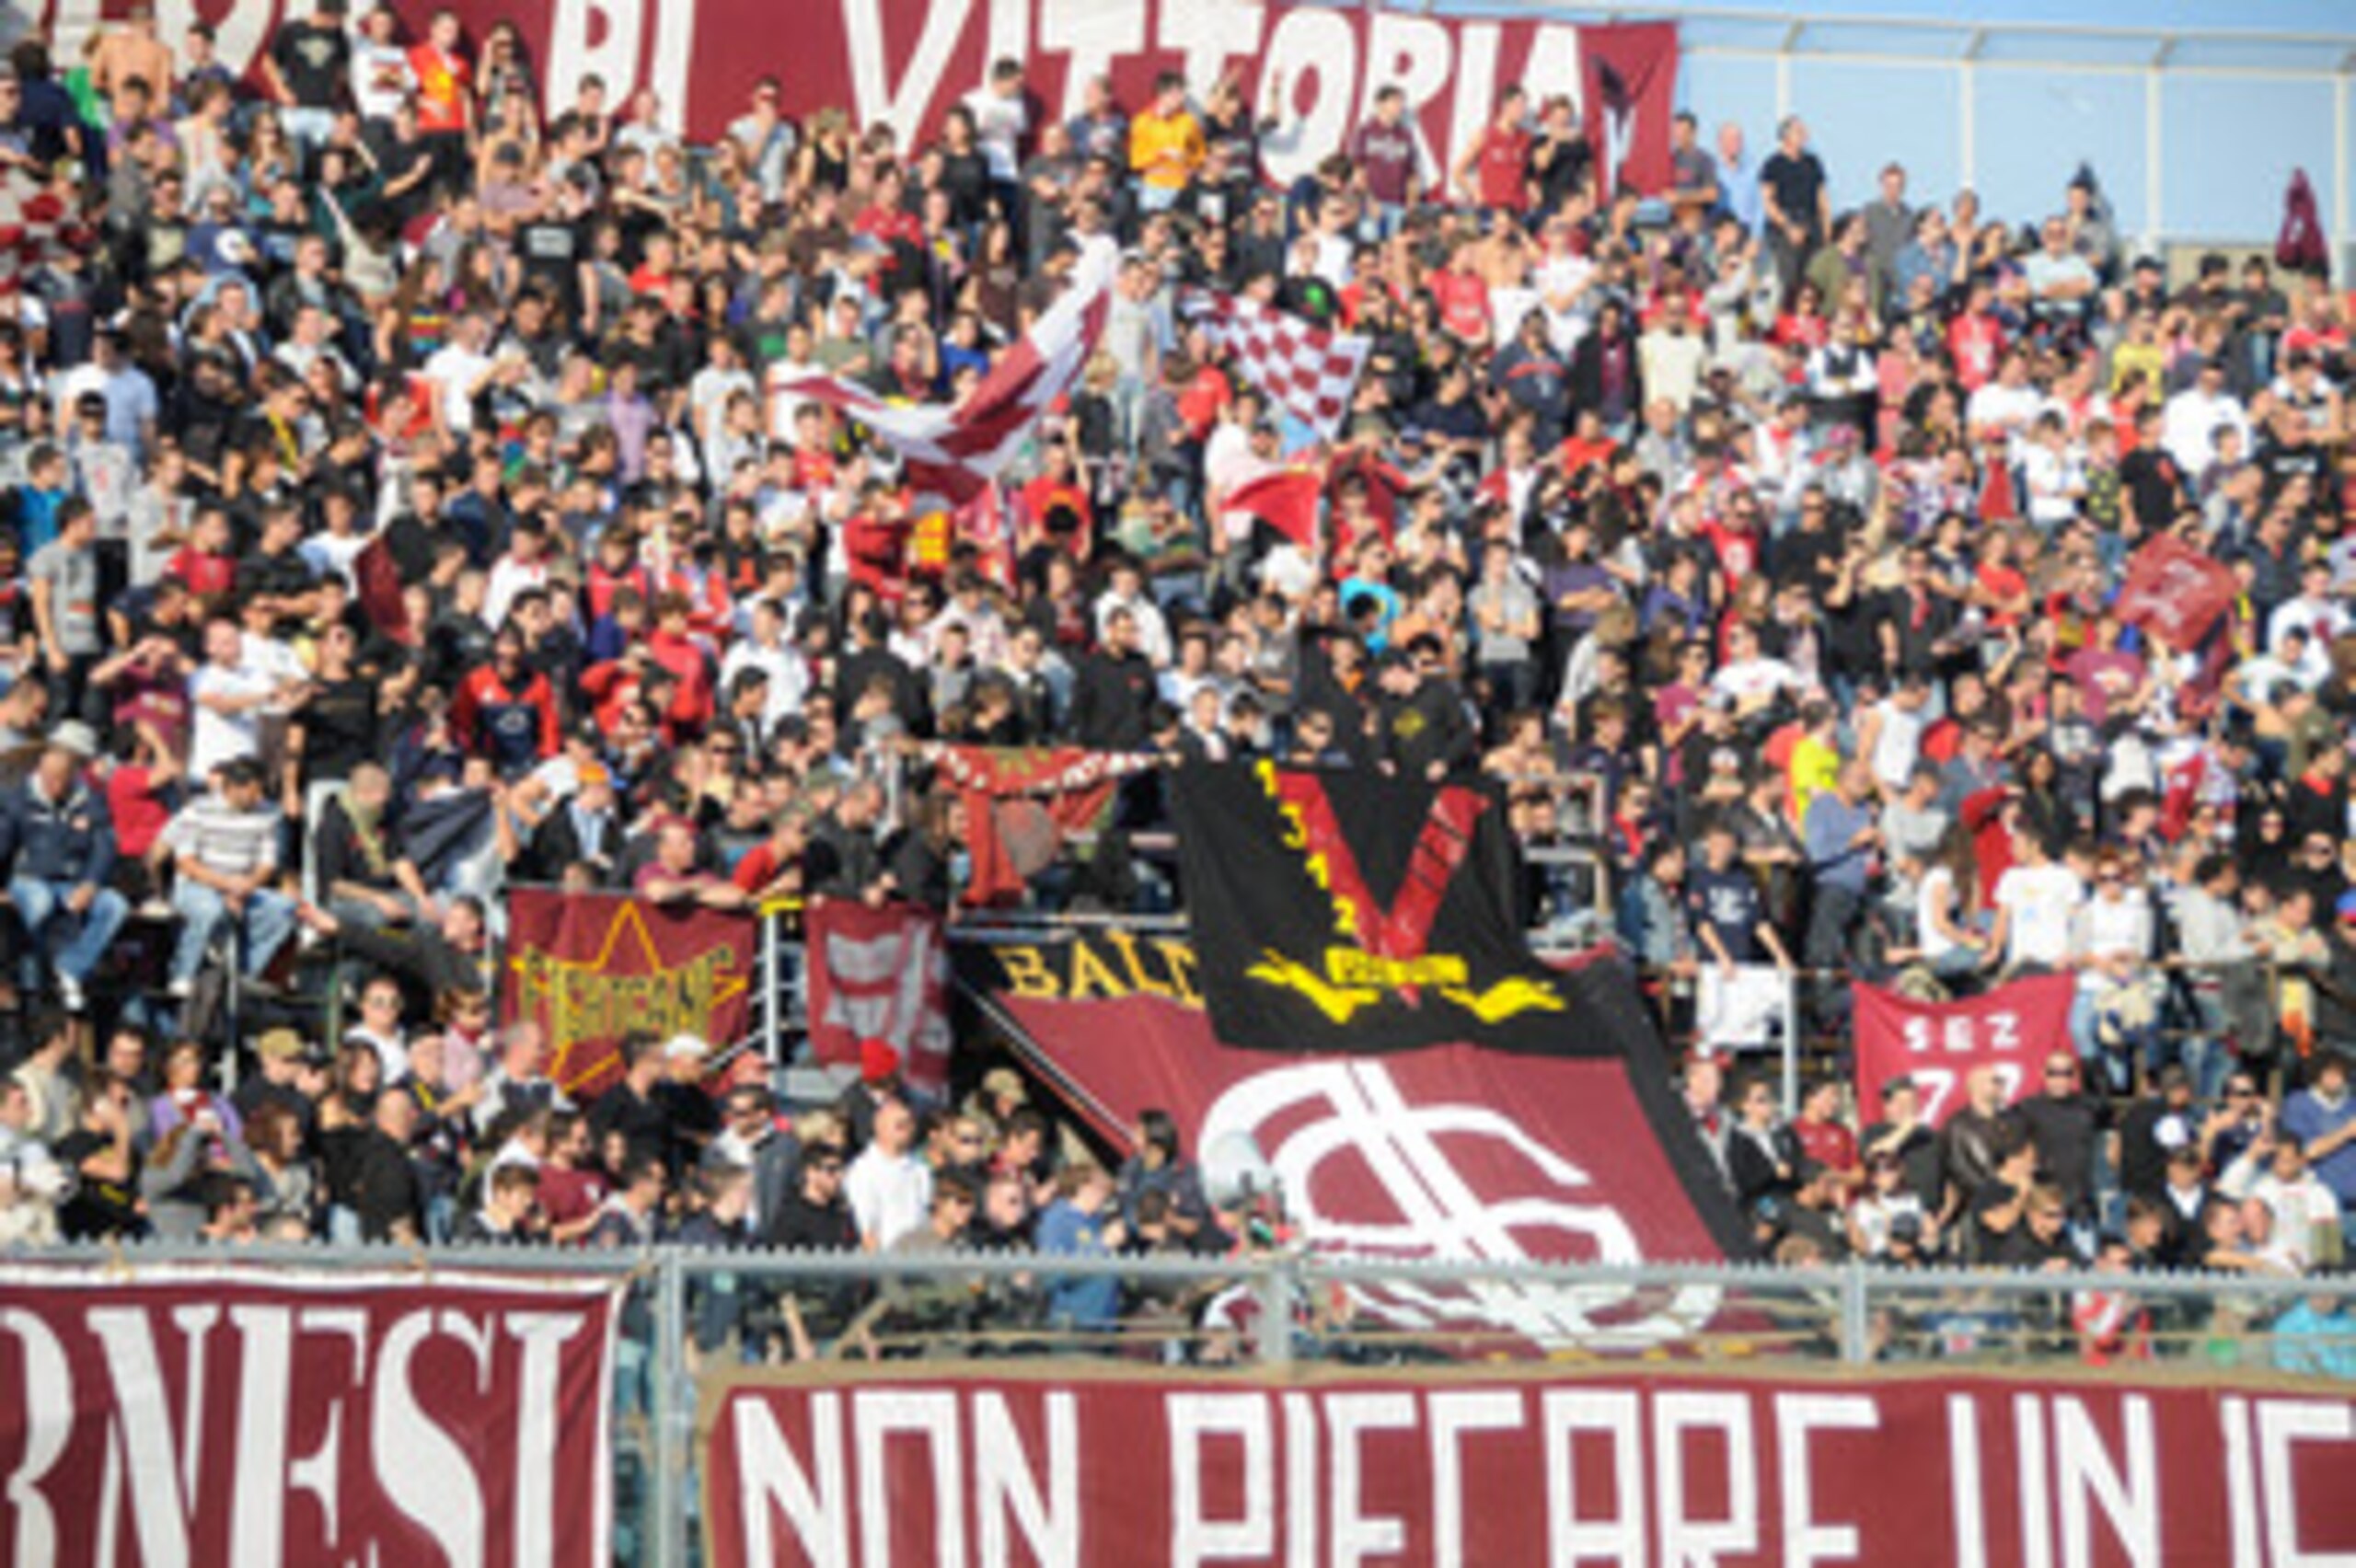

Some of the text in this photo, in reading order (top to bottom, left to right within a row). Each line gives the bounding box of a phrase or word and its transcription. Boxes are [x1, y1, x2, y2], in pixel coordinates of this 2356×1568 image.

[839, 0, 1590, 197] VITTORIA
[1902, 1011, 2021, 1052] SEZ
[733, 1391, 1079, 1568] NON
